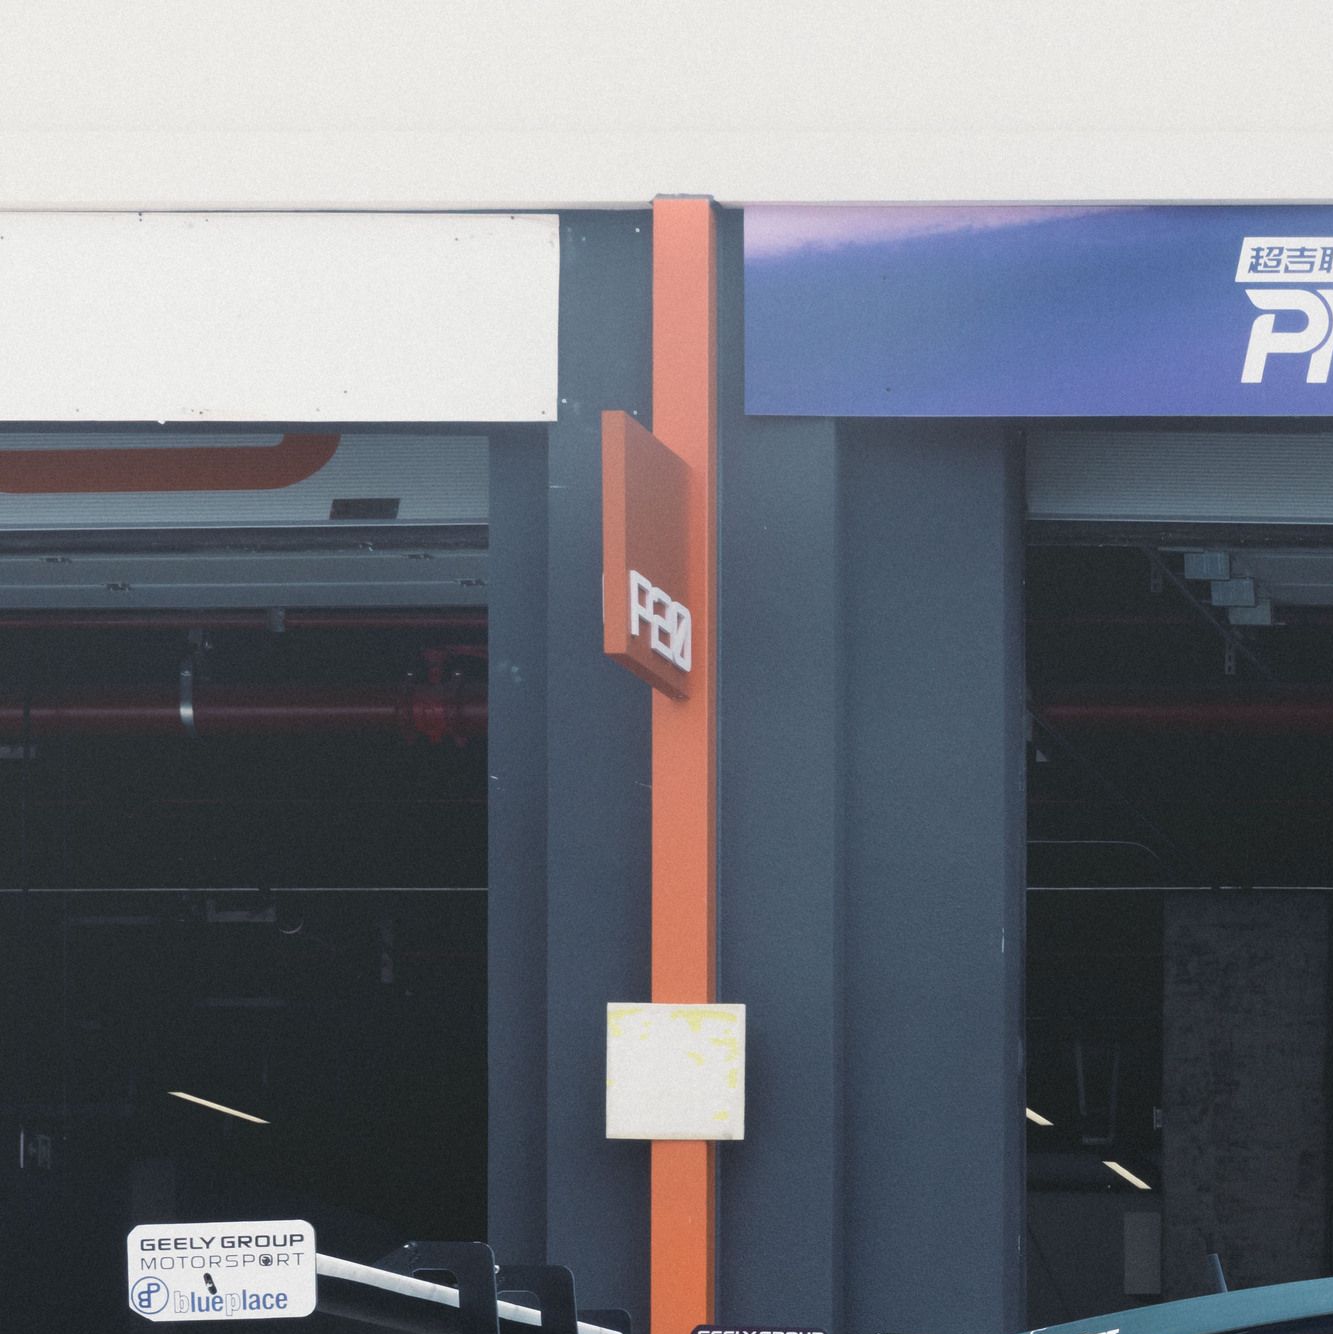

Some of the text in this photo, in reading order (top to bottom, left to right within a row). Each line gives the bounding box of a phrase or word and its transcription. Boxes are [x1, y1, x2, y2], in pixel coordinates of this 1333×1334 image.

[140, 1234, 304, 1251] GEELY GROUP
[140, 1252, 305, 1271] MOTORSPORT
[174, 1289, 288, 1316] blueplace
